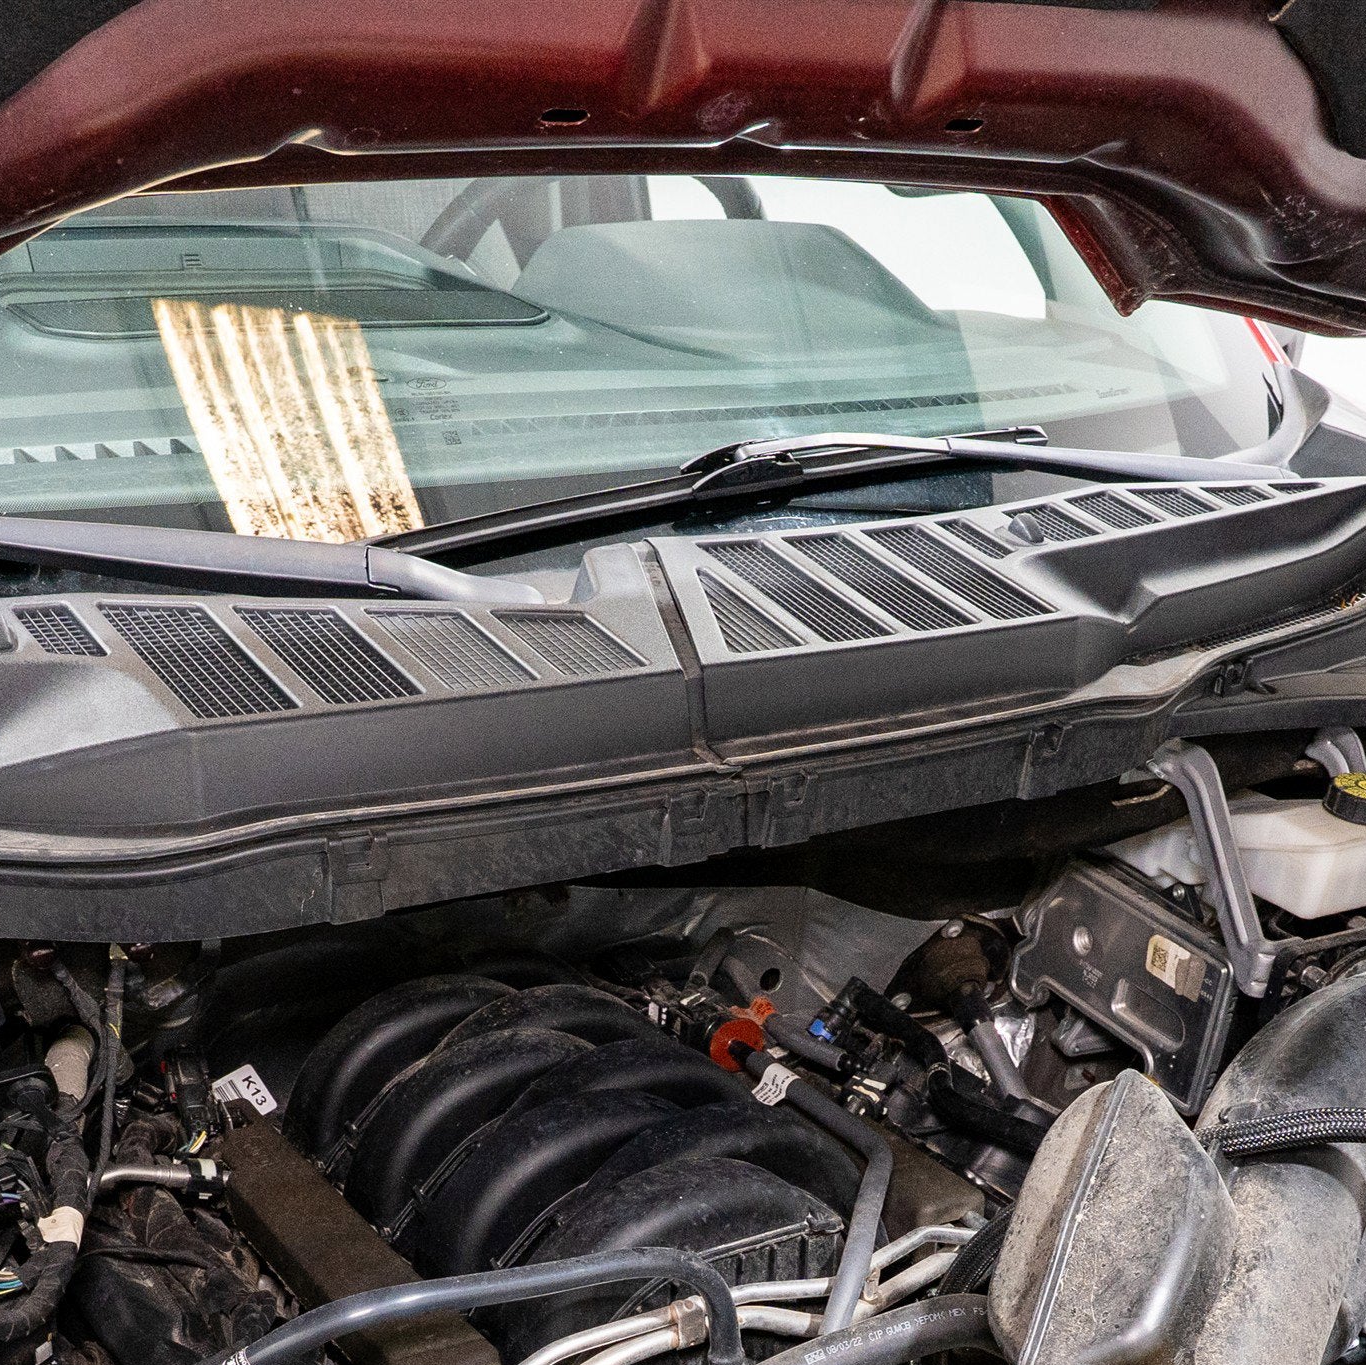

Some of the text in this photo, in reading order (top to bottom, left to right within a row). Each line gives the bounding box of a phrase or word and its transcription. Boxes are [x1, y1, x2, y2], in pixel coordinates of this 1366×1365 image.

[241, 1074, 267, 1106] K13
[868, 1329, 884, 1343] CIP
[949, 1307, 967, 1319] MEX
